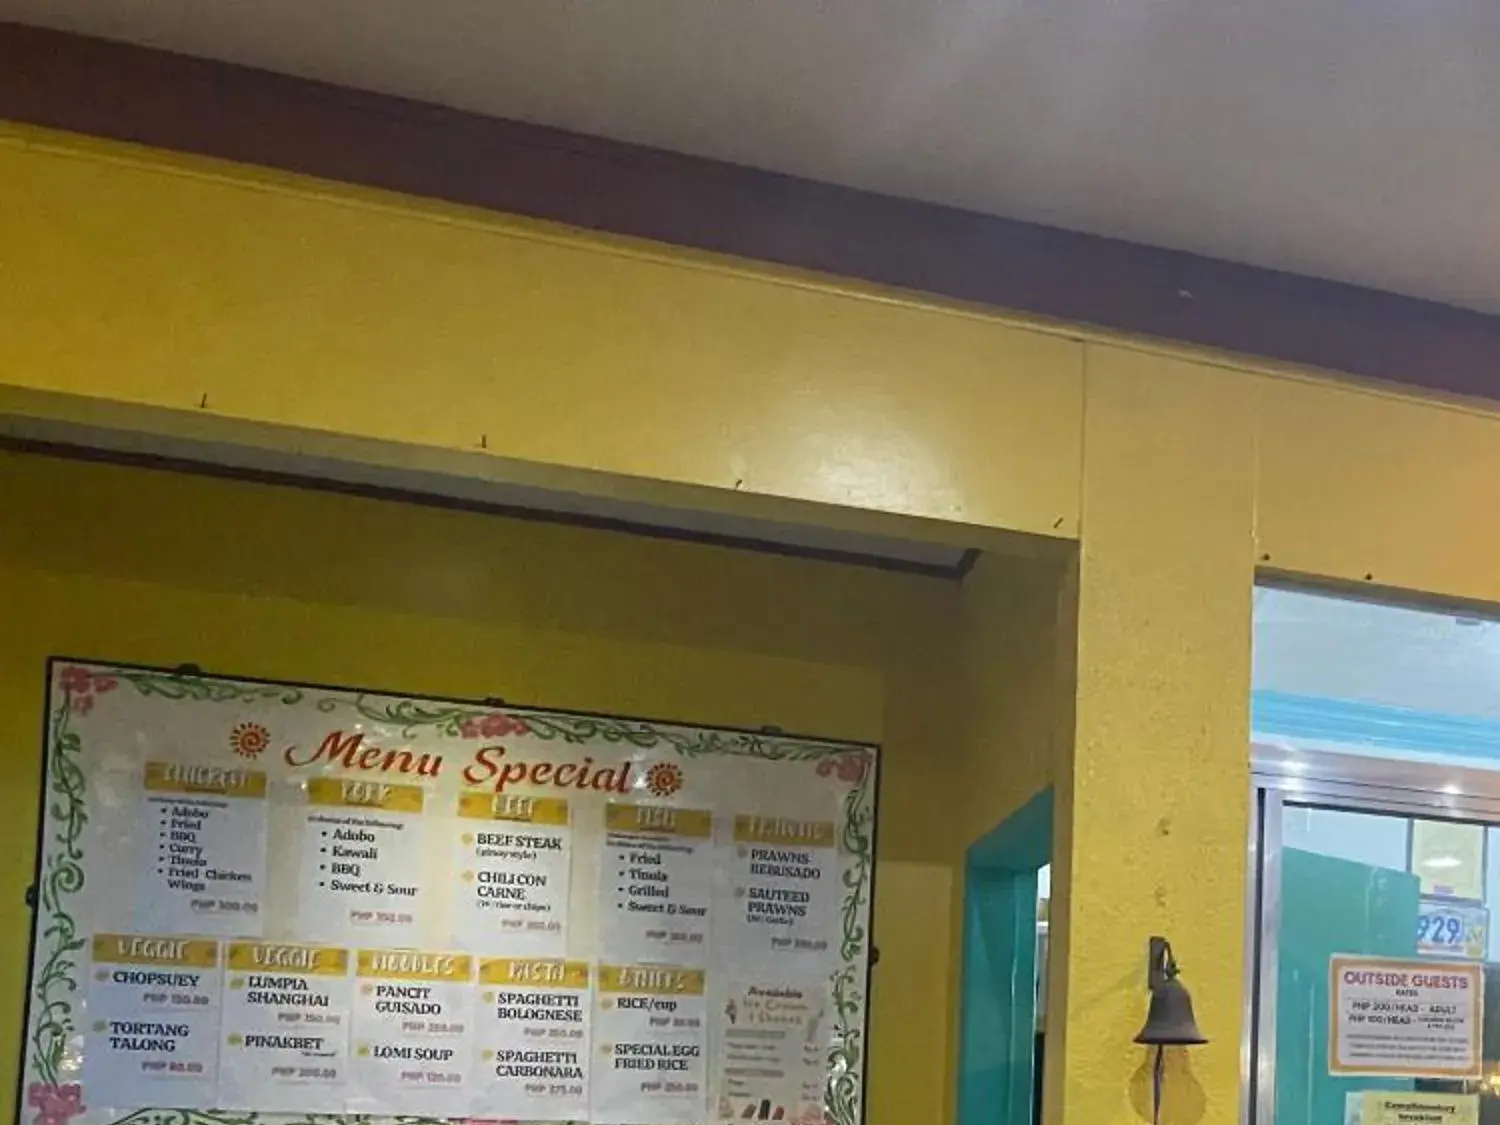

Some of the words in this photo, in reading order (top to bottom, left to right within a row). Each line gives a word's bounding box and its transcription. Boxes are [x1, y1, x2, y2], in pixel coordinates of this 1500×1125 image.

[285, 730, 443, 778] Menu
[463, 746, 634, 794] Special
[170, 819, 202, 830] Fried
[170, 831, 197, 843] BBQ
[332, 829, 375, 843] Adobo
[477, 833, 513, 846] BEEF
[515, 835, 563, 850] STEAK
[169, 843, 203, 858] Curry
[332, 845, 378, 860] Kawali
[629, 852, 662, 865] Fried
[168, 868, 200, 880] Fried
[331, 863, 361, 877] BBQ
[167, 879, 206, 892] Wings
[477, 871, 515, 885] CHILI
[517, 873, 547, 887] CON
[330, 880, 370, 894] Sweet
[387, 884, 419, 897] Sour
[477, 886, 527, 901] CARNE
[628, 885, 670, 898] Grilled
[747, 902, 807, 917] PRAWNS
[117, 937, 189, 960] VEGGIE
[112, 970, 200, 987] CHOPSUEY
[248, 976, 309, 991] LUMPIA
[1344, 971, 1409, 986] OUTSIDE
[1411, 974, 1469, 989] GUESTS
[247, 991, 329, 1007] SHANGHAI
[376, 985, 432, 999] PANCIT
[497, 992, 579, 1007] SPAGHETTI
[375, 1001, 442, 1016] GUISADO
[617, 997, 677, 1013] RICE/cup
[497, 1007, 583, 1023] BOLOGNESE
[109, 1021, 190, 1038] TORTANG
[109, 1037, 176, 1053] TALONG
[614, 1043, 671, 1057] SPECIAL
[673, 1045, 700, 1058] EGG
[374, 1045, 412, 1059] LOMI
[413, 1047, 454, 1061] SOUP
[496, 1050, 577, 1065] SPAGHETTI
[495, 1064, 584, 1080] CARBONARA
[614, 1058, 655, 1070] FRIED
[657, 1058, 689, 1071] RICE
